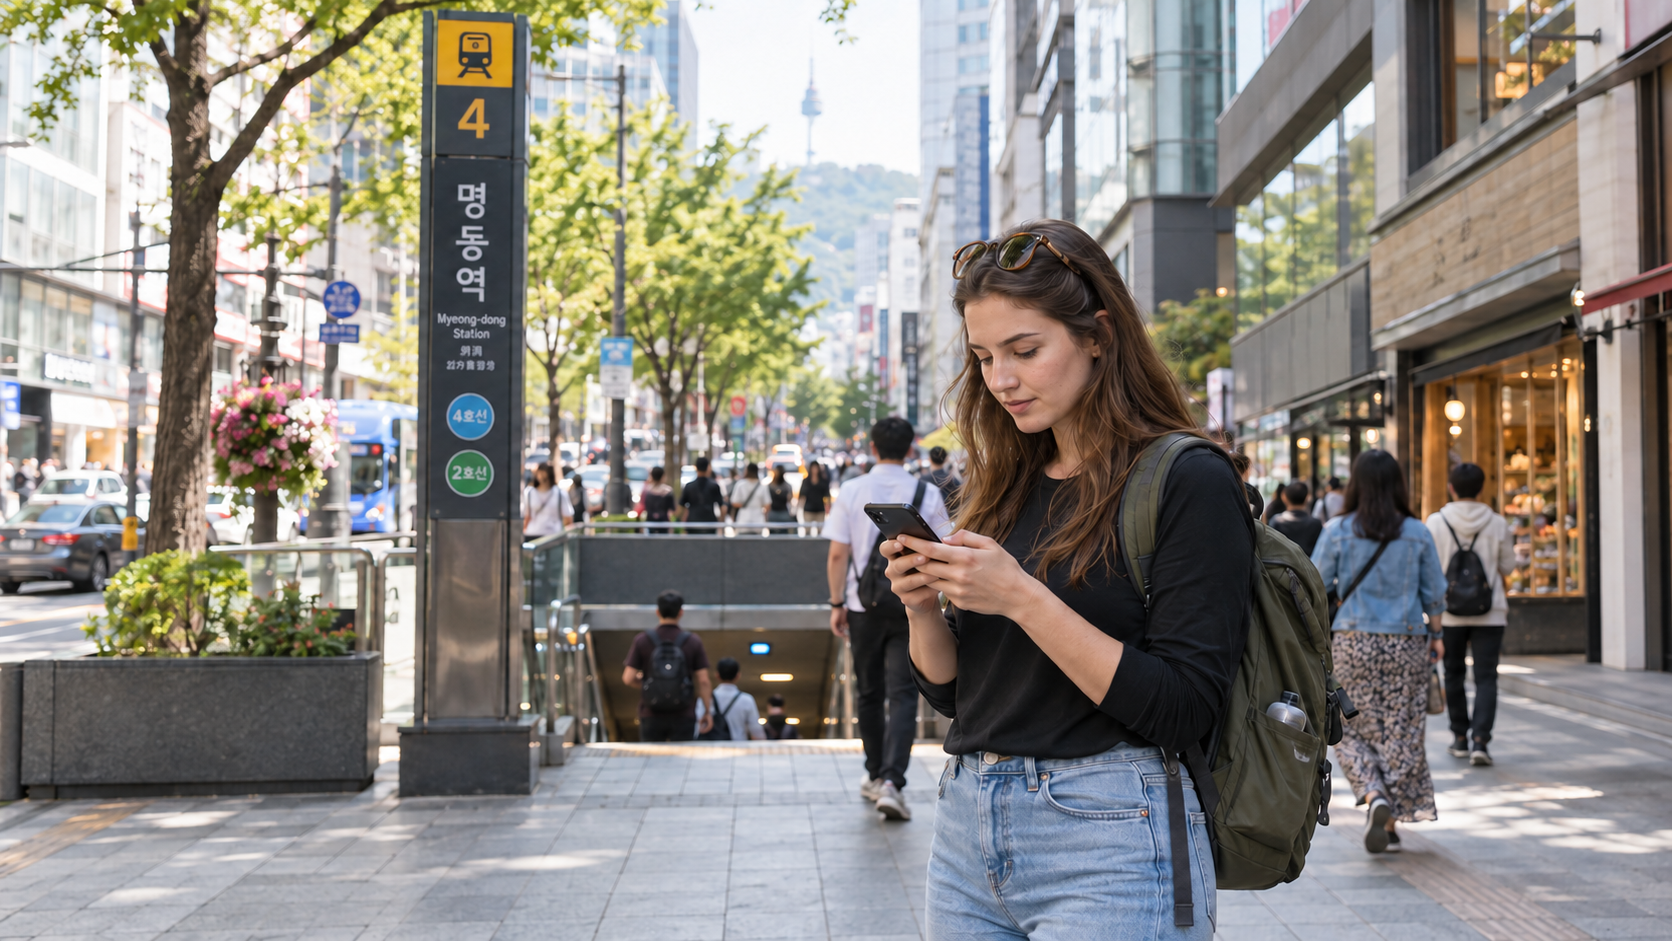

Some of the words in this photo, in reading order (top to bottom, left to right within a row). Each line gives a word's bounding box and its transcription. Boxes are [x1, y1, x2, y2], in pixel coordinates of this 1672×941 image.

[457, 98, 490, 139] 4
[455, 182, 490, 303] 명동역
[437, 312, 507, 328] Myeong-dong
[453, 328, 491, 339] Station
[452, 408, 488, 424] 4호선
[451, 465, 488, 481] 2호선
